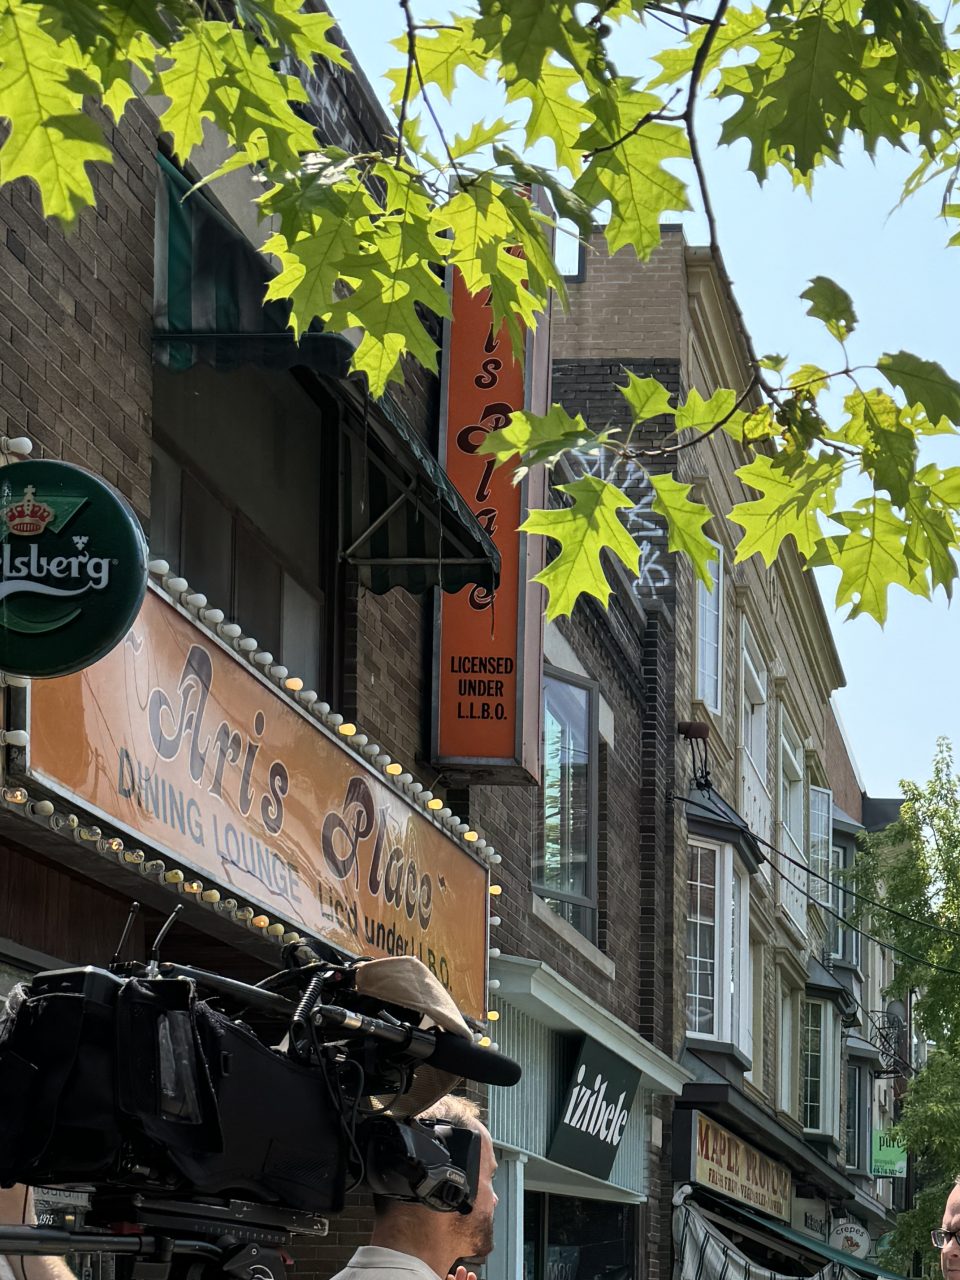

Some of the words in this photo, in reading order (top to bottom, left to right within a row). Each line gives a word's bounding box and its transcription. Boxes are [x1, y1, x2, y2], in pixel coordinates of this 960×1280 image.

[457, 403, 512, 611] Plae
[0, 544, 111, 589] lsberg
[450, 655, 514, 674] LICENSED
[458, 679, 504, 697] UNDER
[457, 702, 508, 720] L.L.B.O.
[148, 643, 289, 836] Aris
[320, 776, 433, 931] Place
[117, 746, 206, 848] DINING
[212, 813, 302, 902] LOUNGE
[364, 914, 409, 957] under
[563, 1063, 628, 1147] izibele
[697, 1116, 740, 1178] MAPLE
[835, 1226, 865, 1237] crepes
